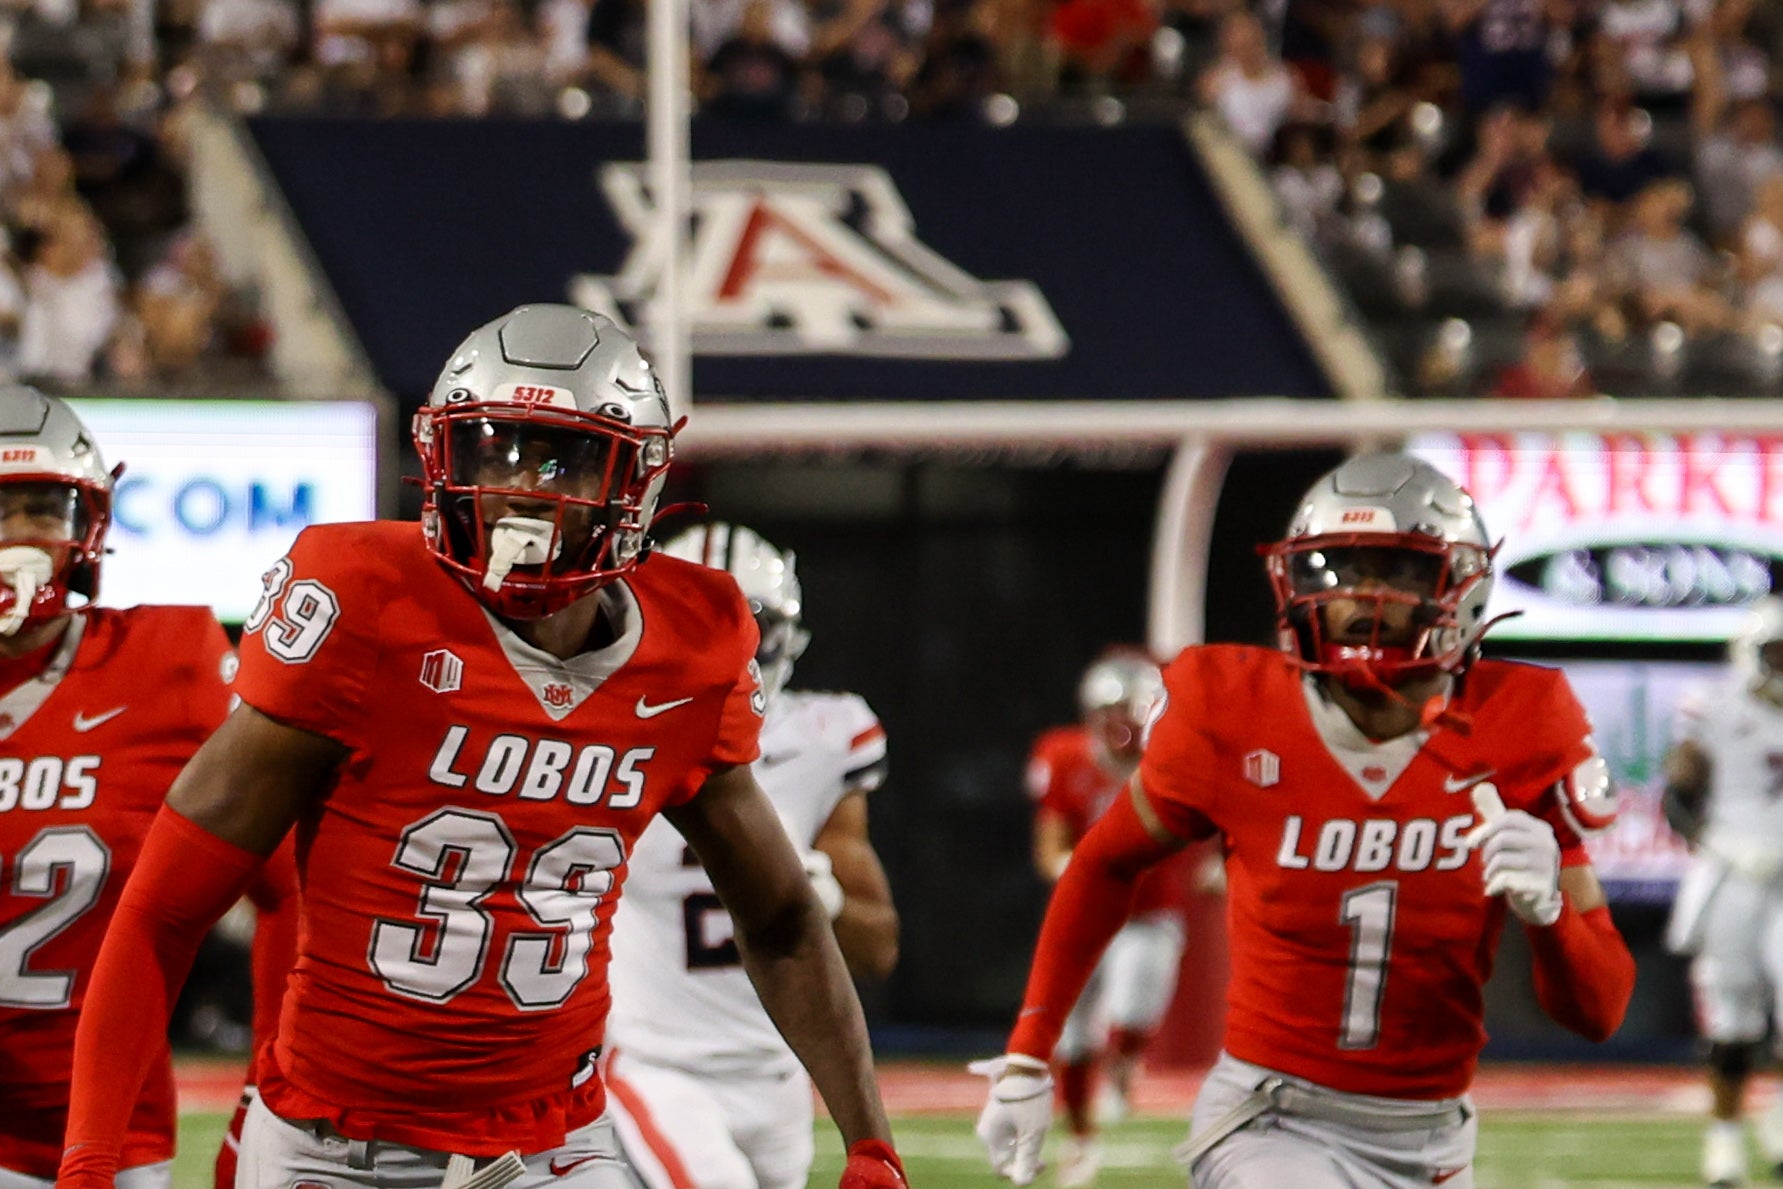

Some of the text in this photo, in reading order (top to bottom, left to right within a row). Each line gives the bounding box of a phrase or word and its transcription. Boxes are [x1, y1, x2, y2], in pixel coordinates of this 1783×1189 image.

[513, 386, 555, 404] 5312
[429, 725, 655, 808] LOBOS
[1276, 814, 1474, 872] LOBOS
[367, 806, 626, 1011] 39
[1336, 880, 1399, 1050] 1
